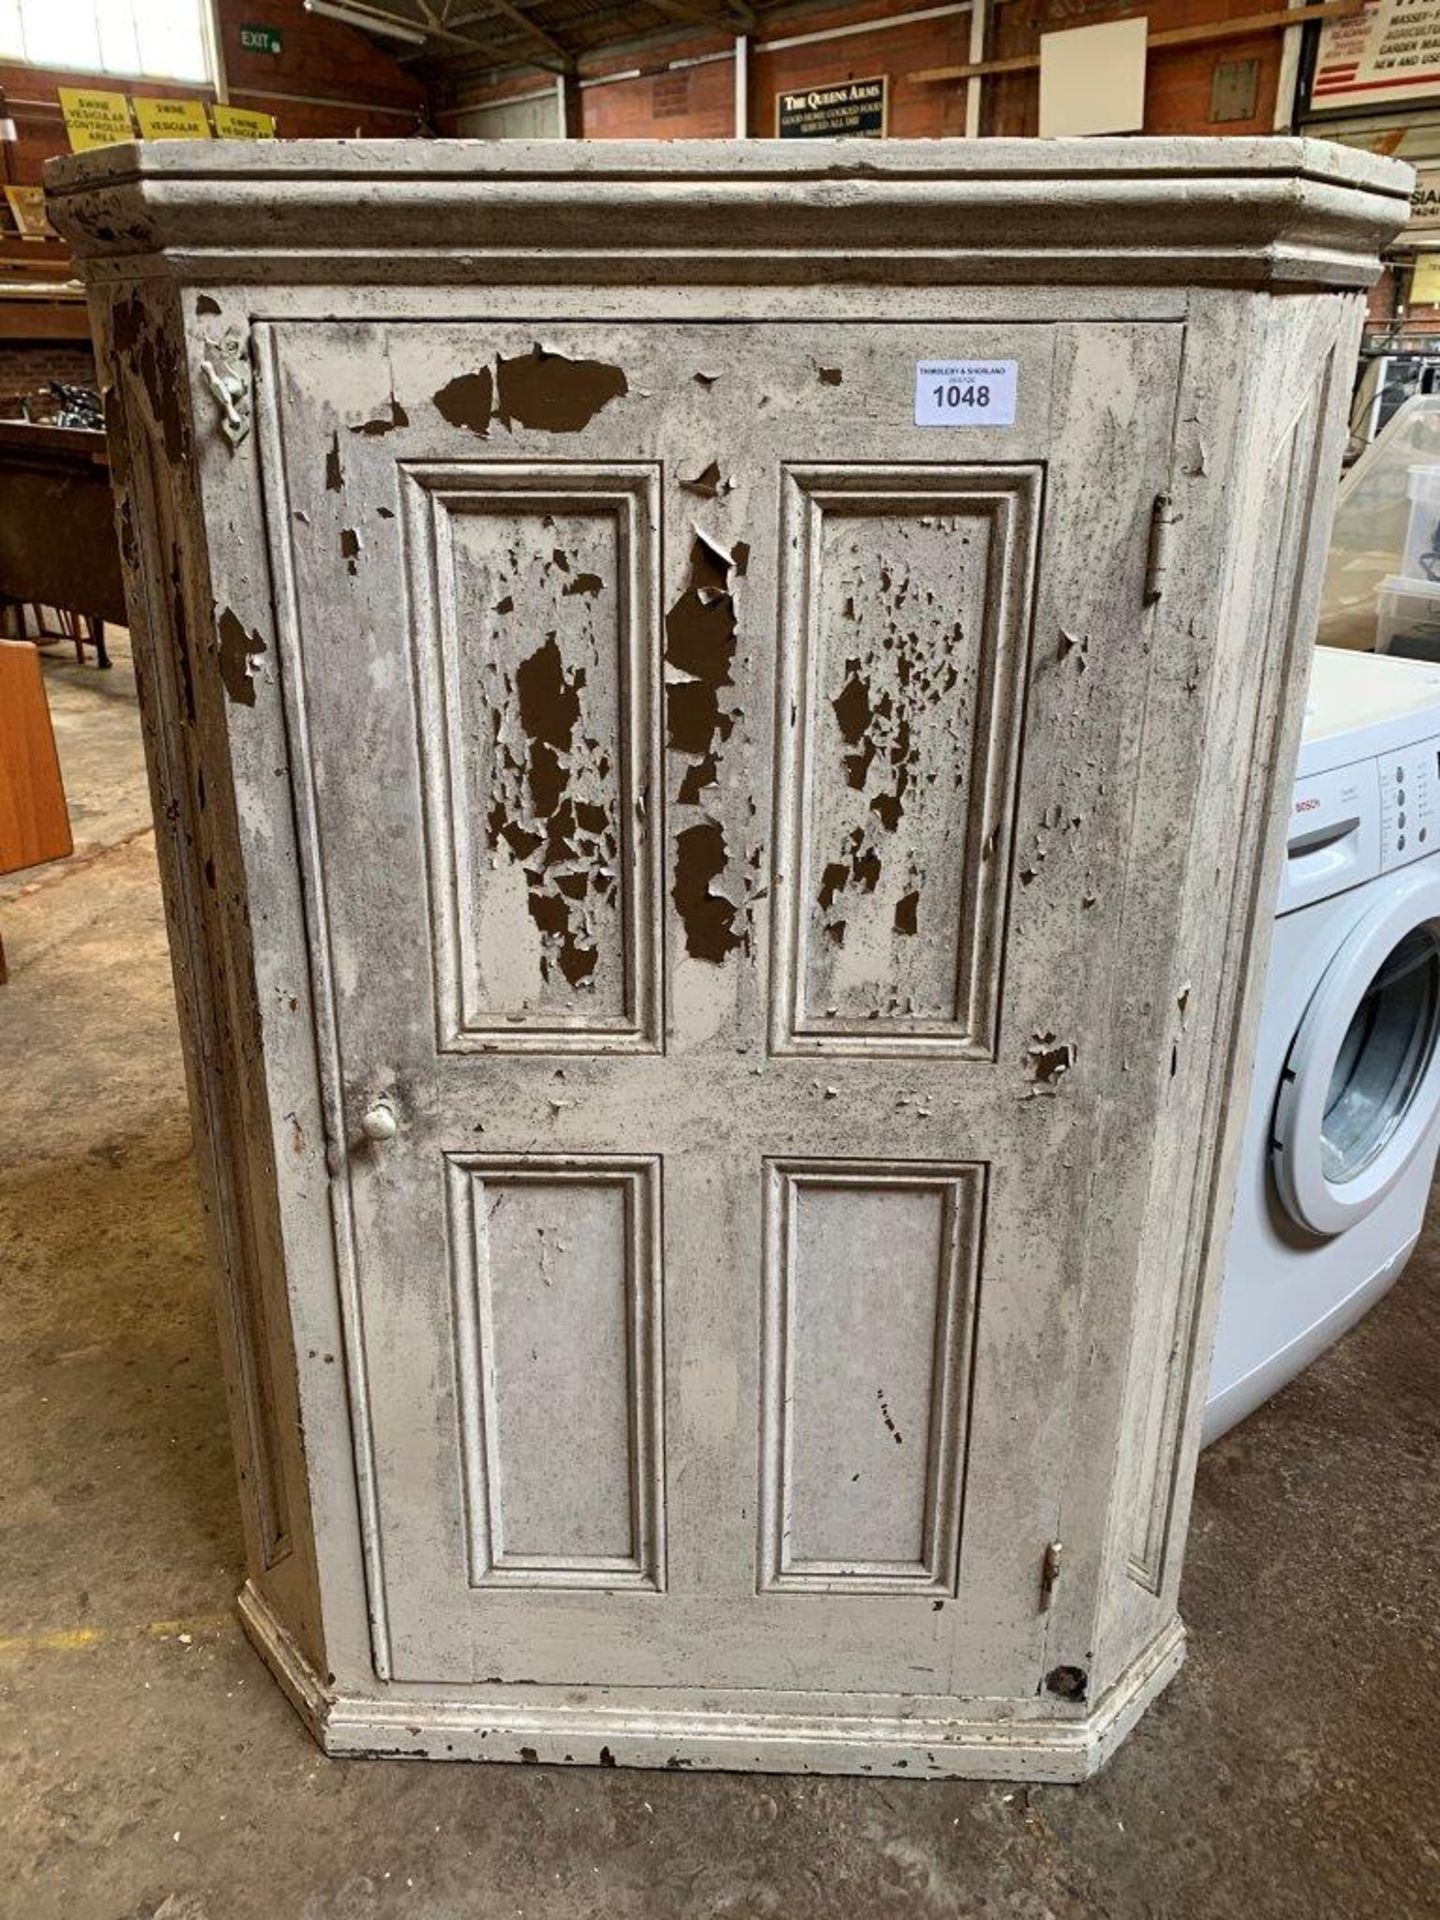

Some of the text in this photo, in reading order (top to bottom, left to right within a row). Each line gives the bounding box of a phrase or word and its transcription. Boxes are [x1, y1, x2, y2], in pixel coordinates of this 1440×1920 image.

[241, 31, 268, 48] EXIT
[1374, 58, 1397, 69] NEW
[1397, 55, 1420, 67] AND
[79, 98, 109, 110] SWINE
[785, 85, 880, 111] THE QUEENS ARMS
[69, 108, 124, 121] VESICULAR
[156, 104, 184, 114] SWINE
[150, 121, 199, 132] VESICULAR
[230, 117, 258, 129] SWINE
[88, 131, 116, 141] AREA
[933, 385, 991, 408] 1048
[1295, 799, 1320, 813] BOSCH
